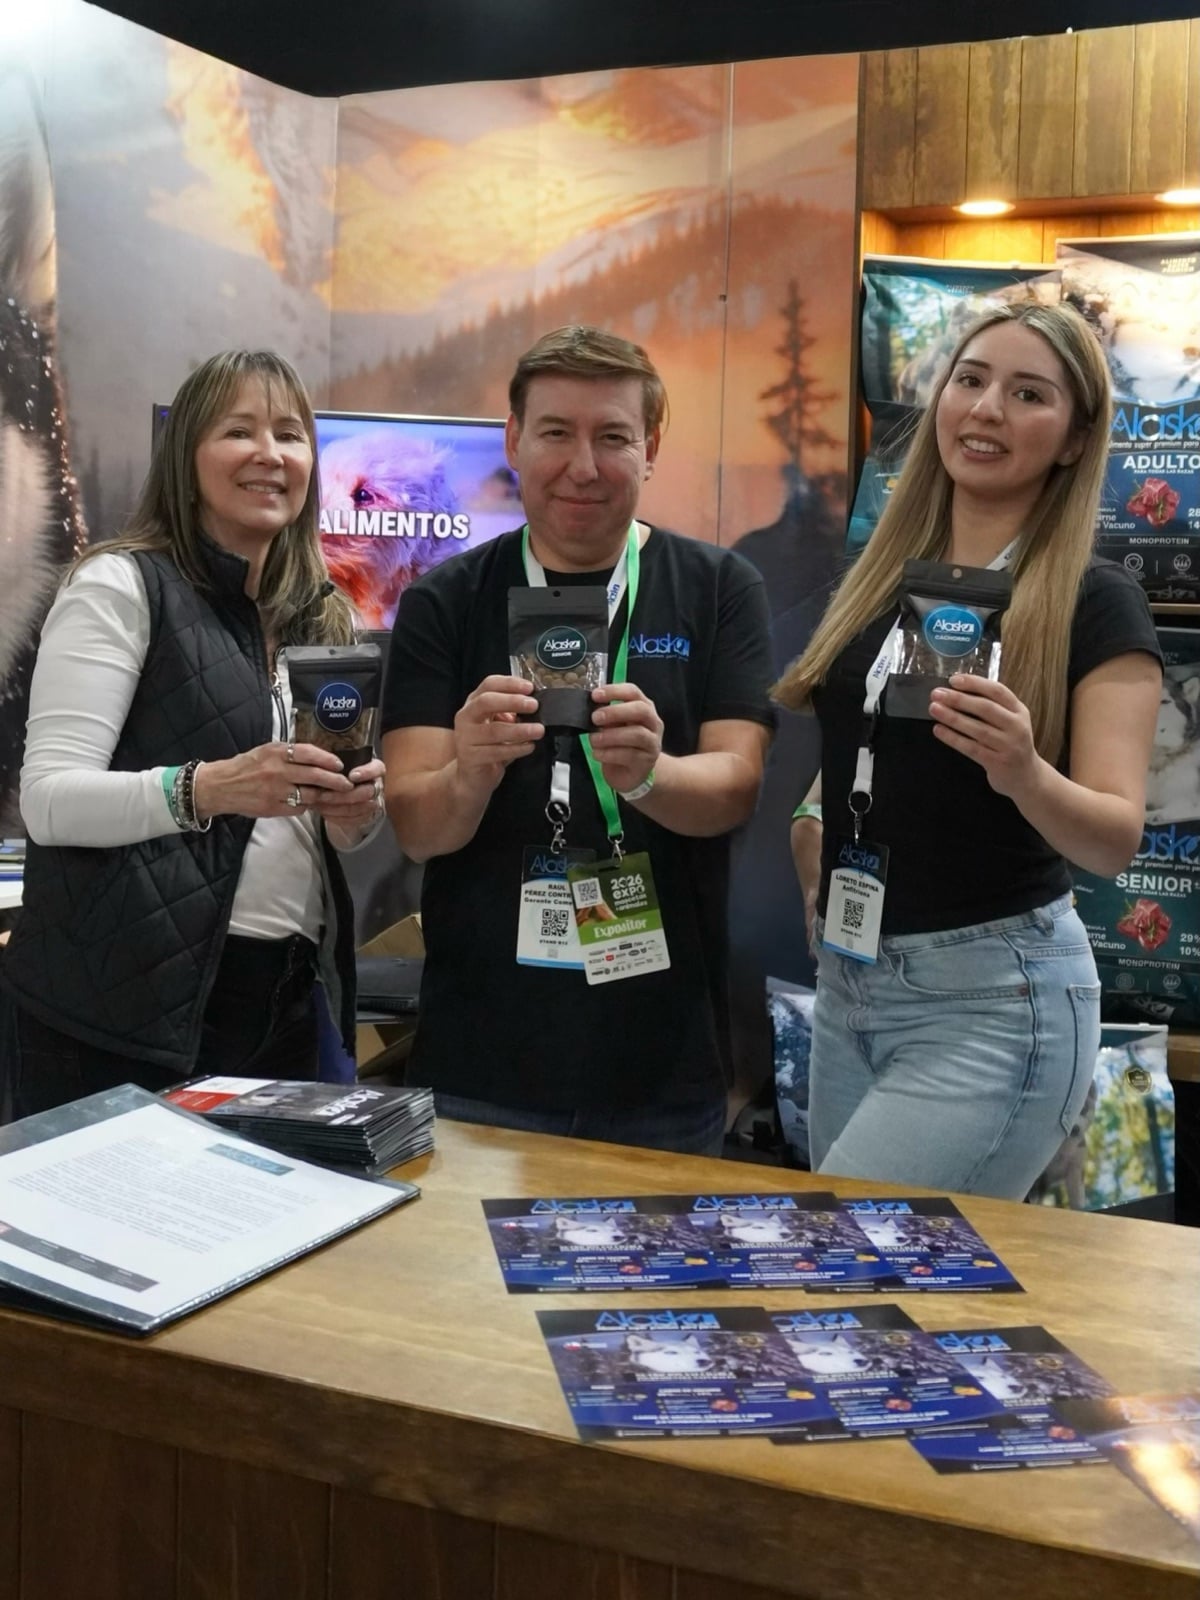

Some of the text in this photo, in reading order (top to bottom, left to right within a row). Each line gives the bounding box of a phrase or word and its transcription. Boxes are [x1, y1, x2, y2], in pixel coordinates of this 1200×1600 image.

[319, 509, 470, 539] ALIMENTOS
[1103, 521, 1136, 529] Vacuno
[1129, 537, 1190, 545] MONOPROTEIN
[932, 617, 975, 634] Alaska
[543, 639, 581, 651] Alaska
[629, 632, 691, 657] Alaska
[322, 696, 357, 710] Alaska
[610, 873, 643, 890] 2026
[1115, 871, 1193, 894] SENIOR
[594, 919, 647, 939] Expositor
[1087, 932, 1106, 940] arne
[1092, 939, 1126, 950] Vacuno
[1118, 958, 1181, 970] MONOPROTEIN
